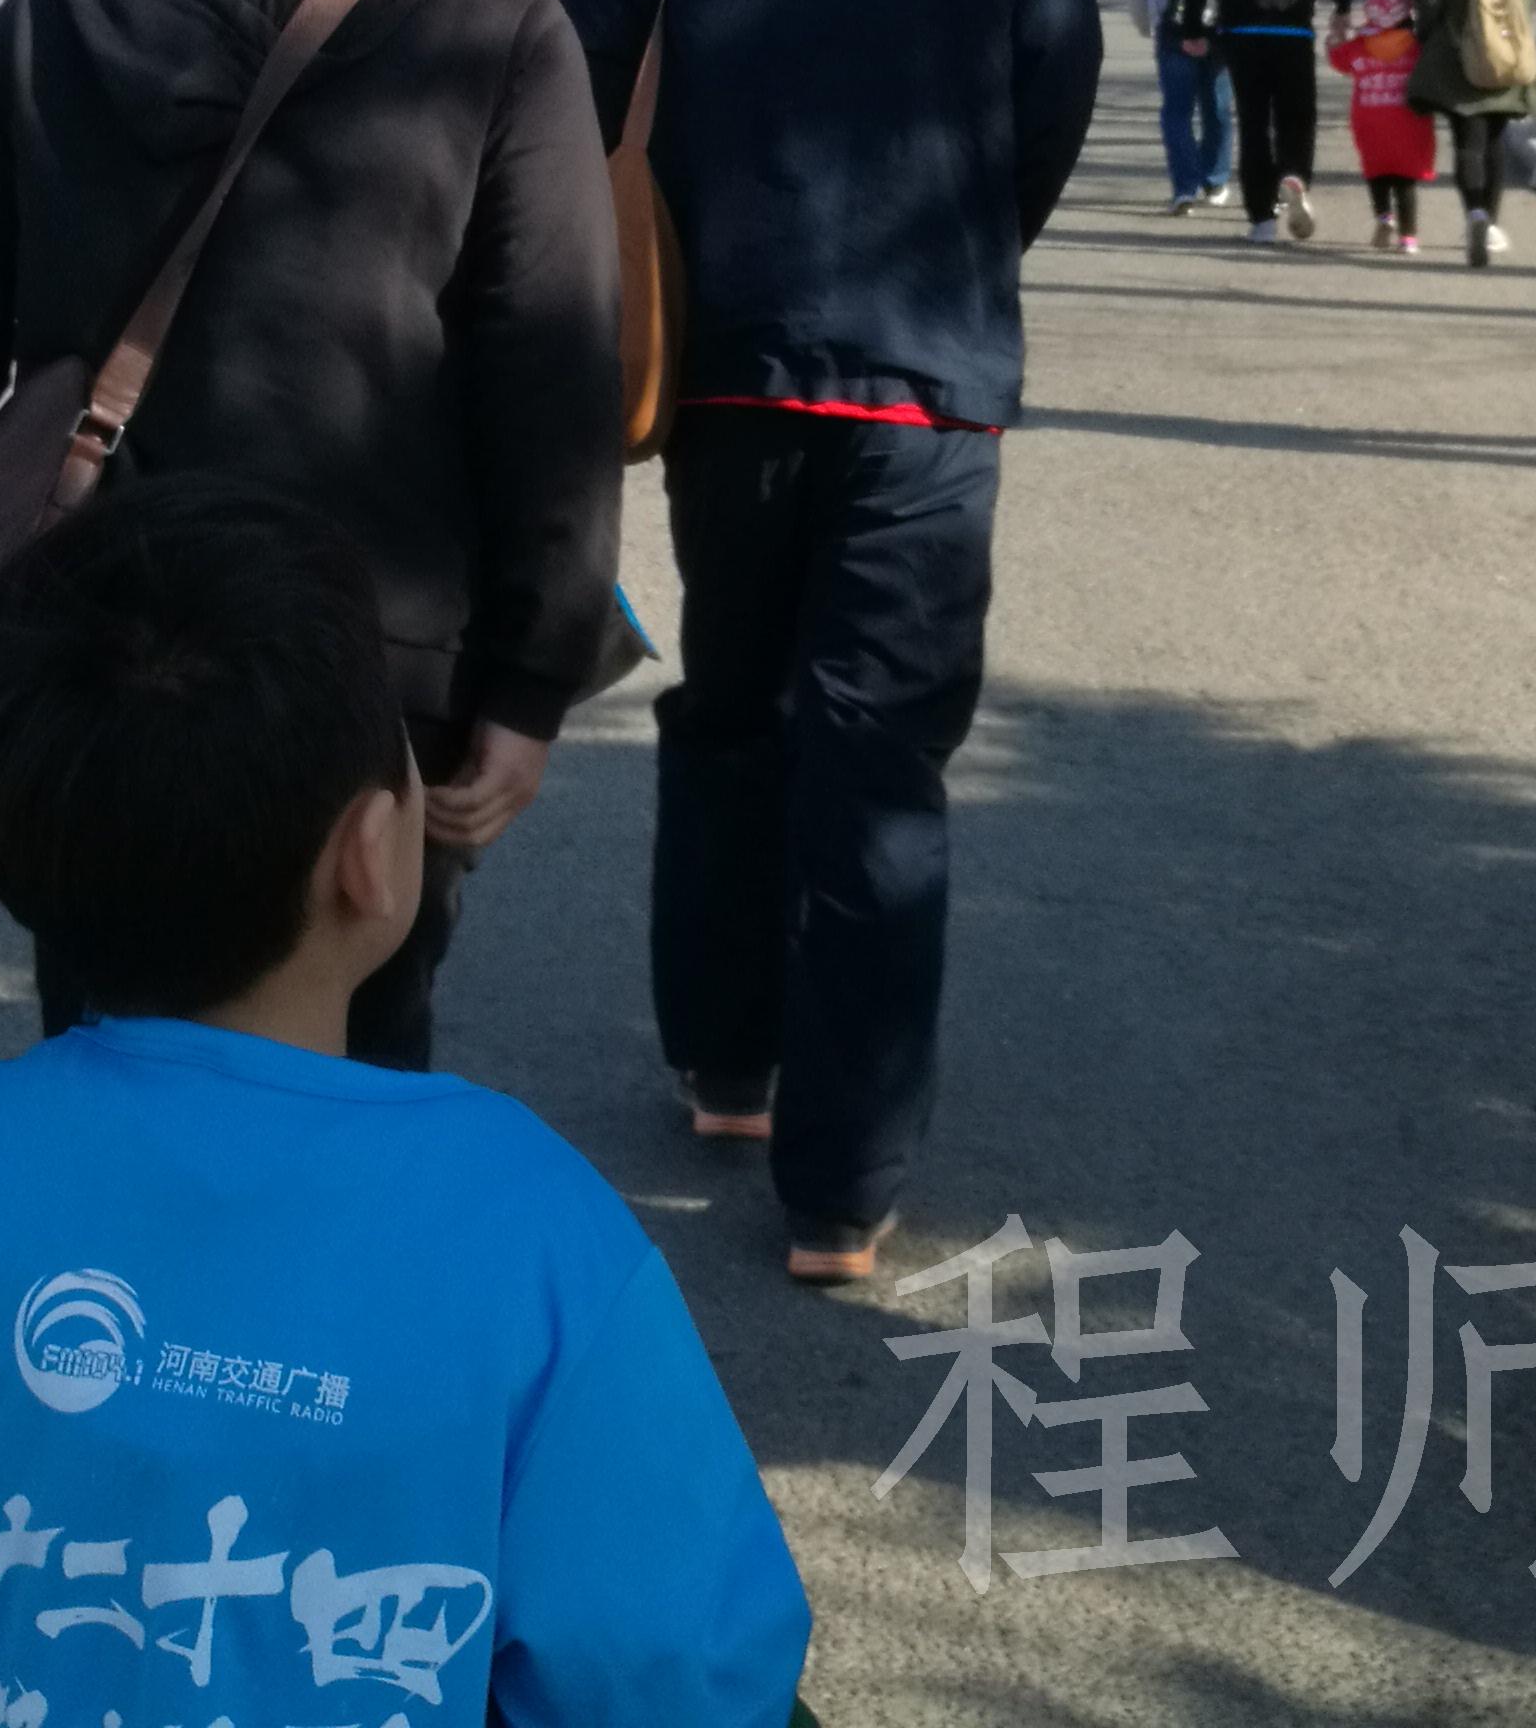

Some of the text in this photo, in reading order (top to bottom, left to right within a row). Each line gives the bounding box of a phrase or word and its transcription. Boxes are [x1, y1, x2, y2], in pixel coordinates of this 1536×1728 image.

[151, 1376, 345, 1426] HENAN TRAFFIC RADIO
[156, 1341, 351, 1409] 河南交通广播
